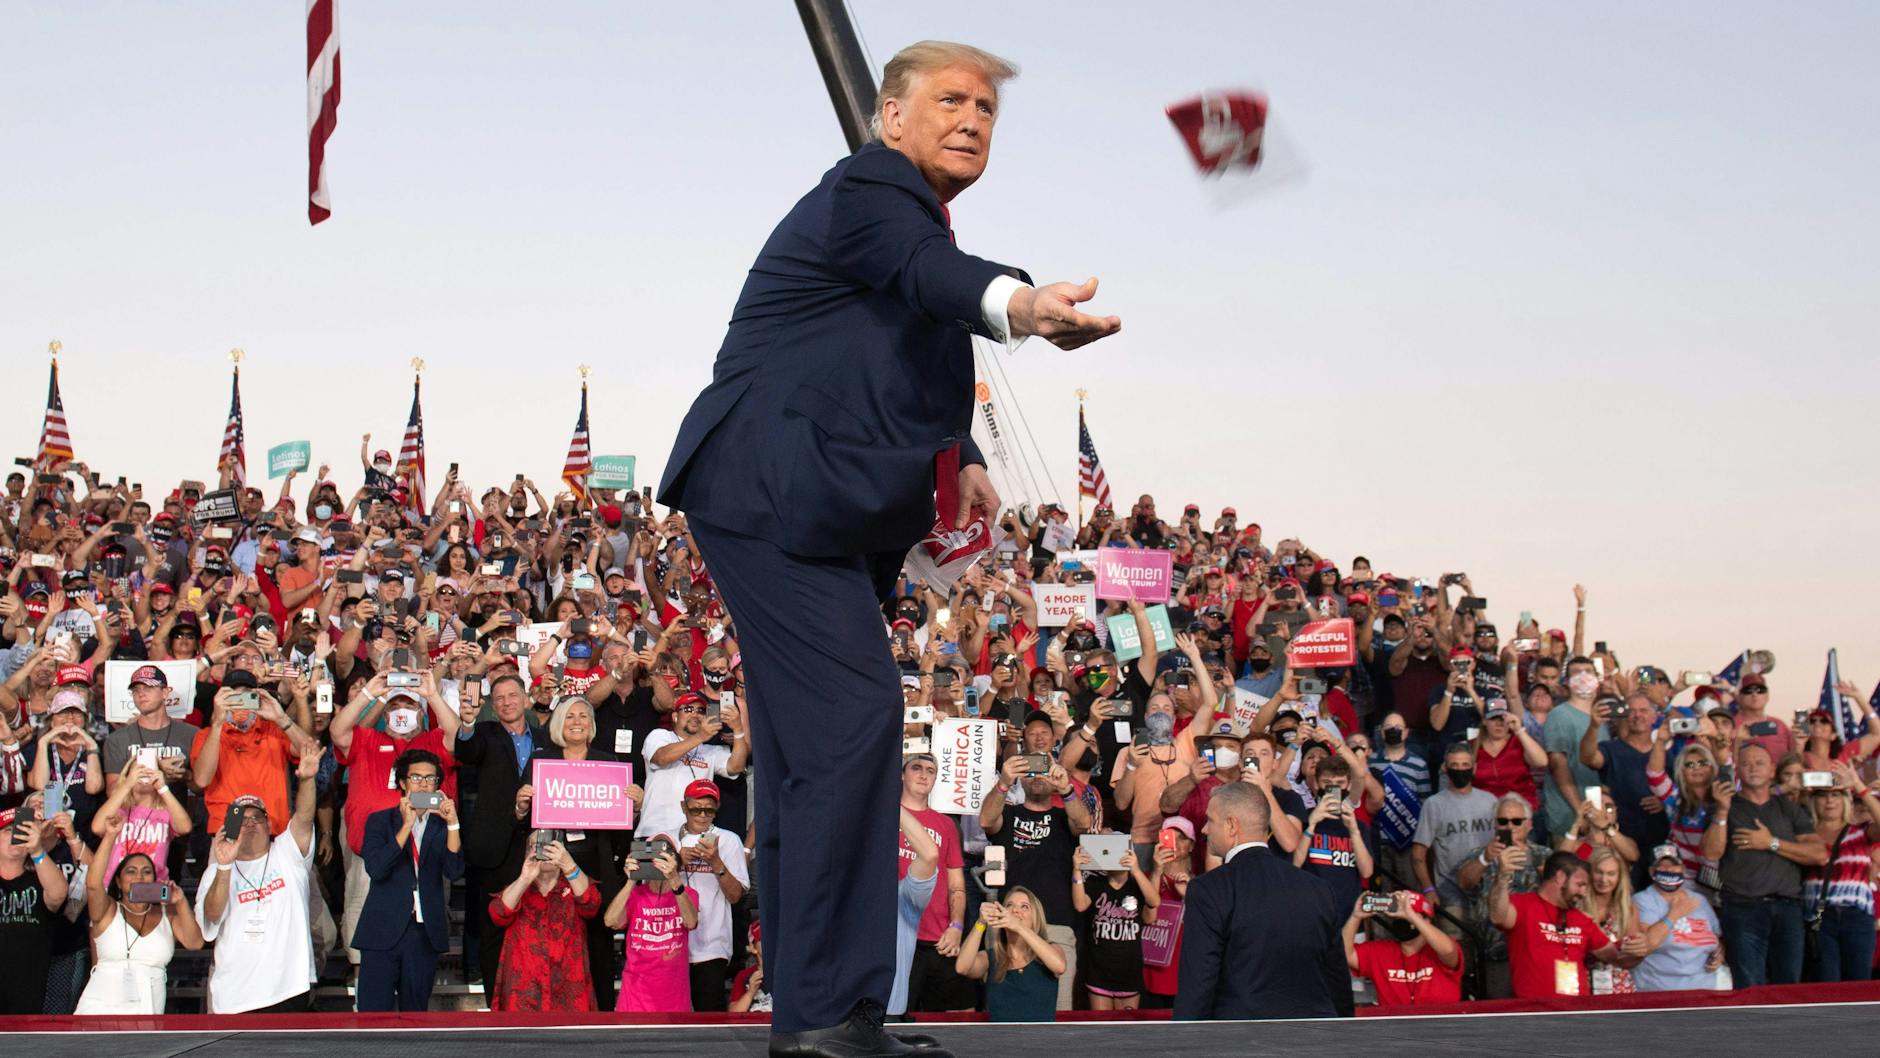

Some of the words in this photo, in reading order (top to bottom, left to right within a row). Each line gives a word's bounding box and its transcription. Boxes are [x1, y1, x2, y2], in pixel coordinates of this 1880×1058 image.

[982, 403, 1000, 439] Sims
[595, 463, 629, 473] Latinos
[1106, 561, 1162, 580] Women
[1131, 579, 1157, 587] TRUMP
[1044, 595, 1051, 603] 4
[1054, 595, 1086, 603] MORE
[1045, 607, 1075, 616] YEAR
[1118, 619, 1162, 639] Latos
[1293, 645, 1348, 654] PROTESTER
[705, 673, 725, 684] MAG
[1244, 699, 1260, 710] MAK
[128, 744, 183, 760] Tmp
[974, 724, 984, 764] AGAIN
[941, 747, 952, 783] MAKE
[953, 724, 970, 808] AMERICA
[545, 778, 620, 800] Women
[970, 770, 982, 809] GREAT
[553, 800, 575, 808] FOR
[578, 801, 613, 809] TRUMP
[1013, 814, 1052, 832] TRUP
[1446, 819, 1494, 836] ARMY
[1031, 826, 1051, 840] 020
[899, 848, 917, 860] NTU
[1332, 851, 1356, 867] 202
[261, 879, 284, 898] TRMP
[1366, 896, 1393, 905] Trump
[642, 906, 676, 916] WOMEN
[634, 917, 683, 934] TRUMP
[1095, 921, 1140, 941] TRUMP
[1539, 922, 1581, 935] TRMP
[1140, 926, 1169, 948] Wom
[1387, 967, 1433, 980] TRUMP
